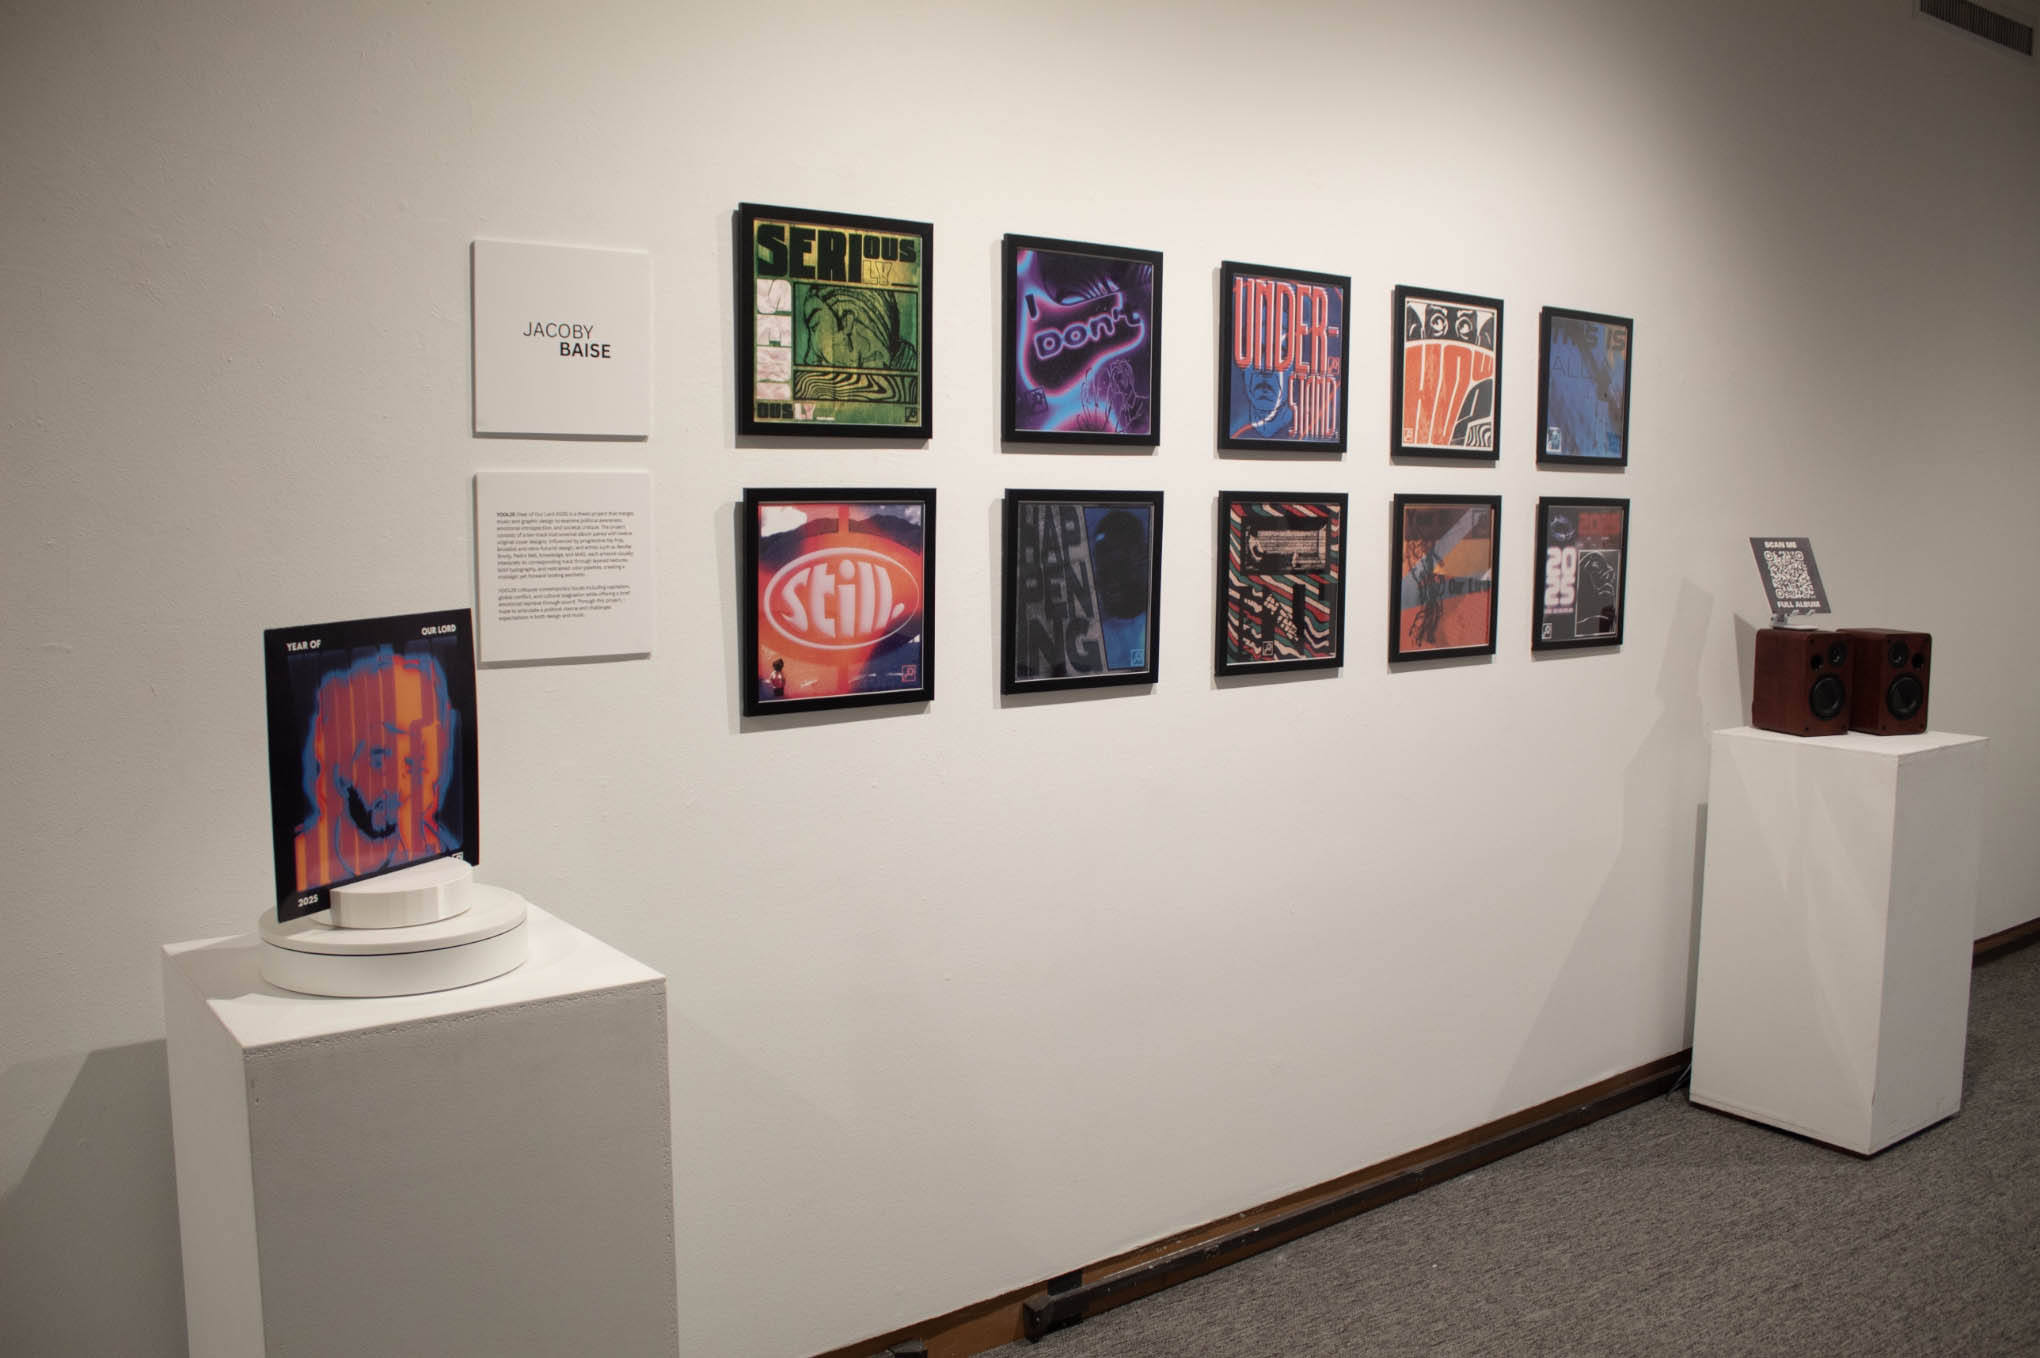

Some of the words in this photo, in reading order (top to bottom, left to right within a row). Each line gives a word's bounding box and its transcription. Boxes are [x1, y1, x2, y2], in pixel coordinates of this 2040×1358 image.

[523, 321, 594, 339] JACOBY
[560, 341, 611, 359] BAISE
[421, 626, 436, 636] OUR
[437, 624, 456, 634] LORD
[286, 640, 308, 651] YEAR
[309, 639, 321, 649] OF
[297, 893, 319, 907] 2025
